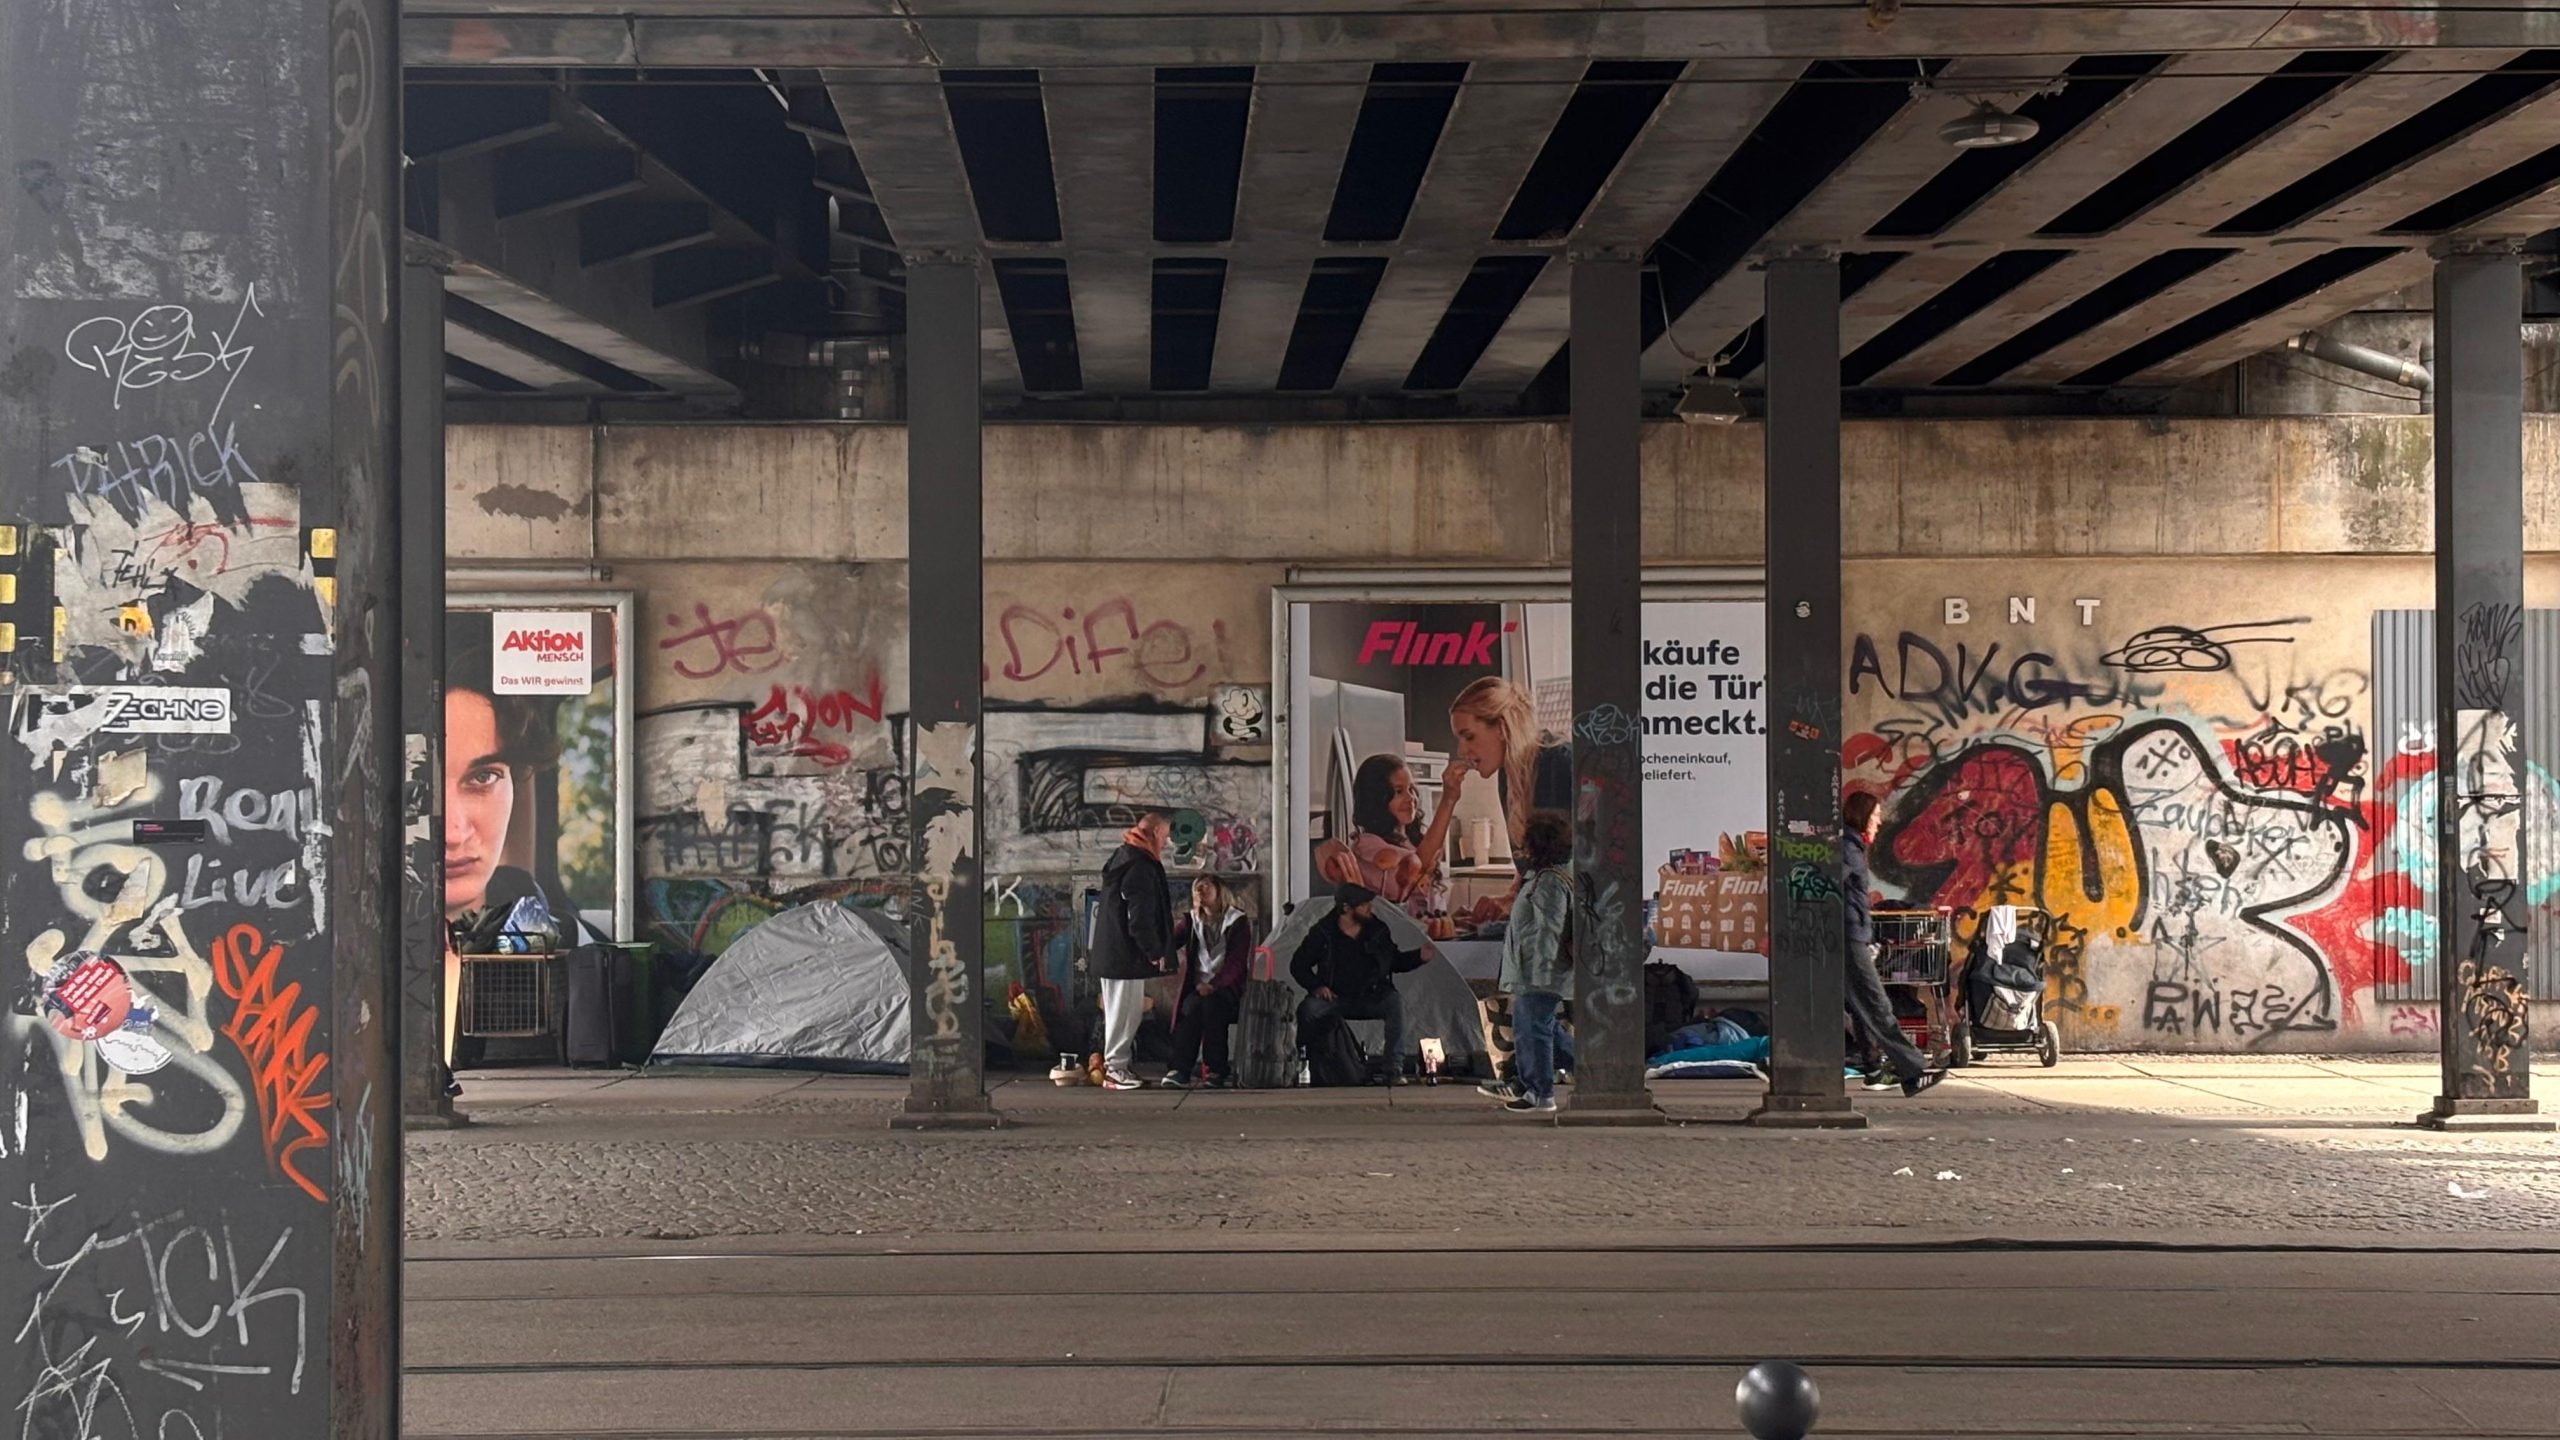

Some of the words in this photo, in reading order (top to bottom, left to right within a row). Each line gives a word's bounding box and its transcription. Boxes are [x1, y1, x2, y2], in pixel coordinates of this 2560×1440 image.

[1356, 620, 1499, 666] Flink
[537, 652, 584, 663] MENSCH
[1643, 639, 1740, 666] käufe
[501, 676, 519, 685] Das
[521, 676, 542, 685] WIR
[544, 675, 584, 687] gewinnt
[1645, 674, 1697, 700] die
[1708, 674, 1766, 700] Tür
[1641, 769, 1696, 781] eliefert.
[1662, 880, 1715, 897] Flink
